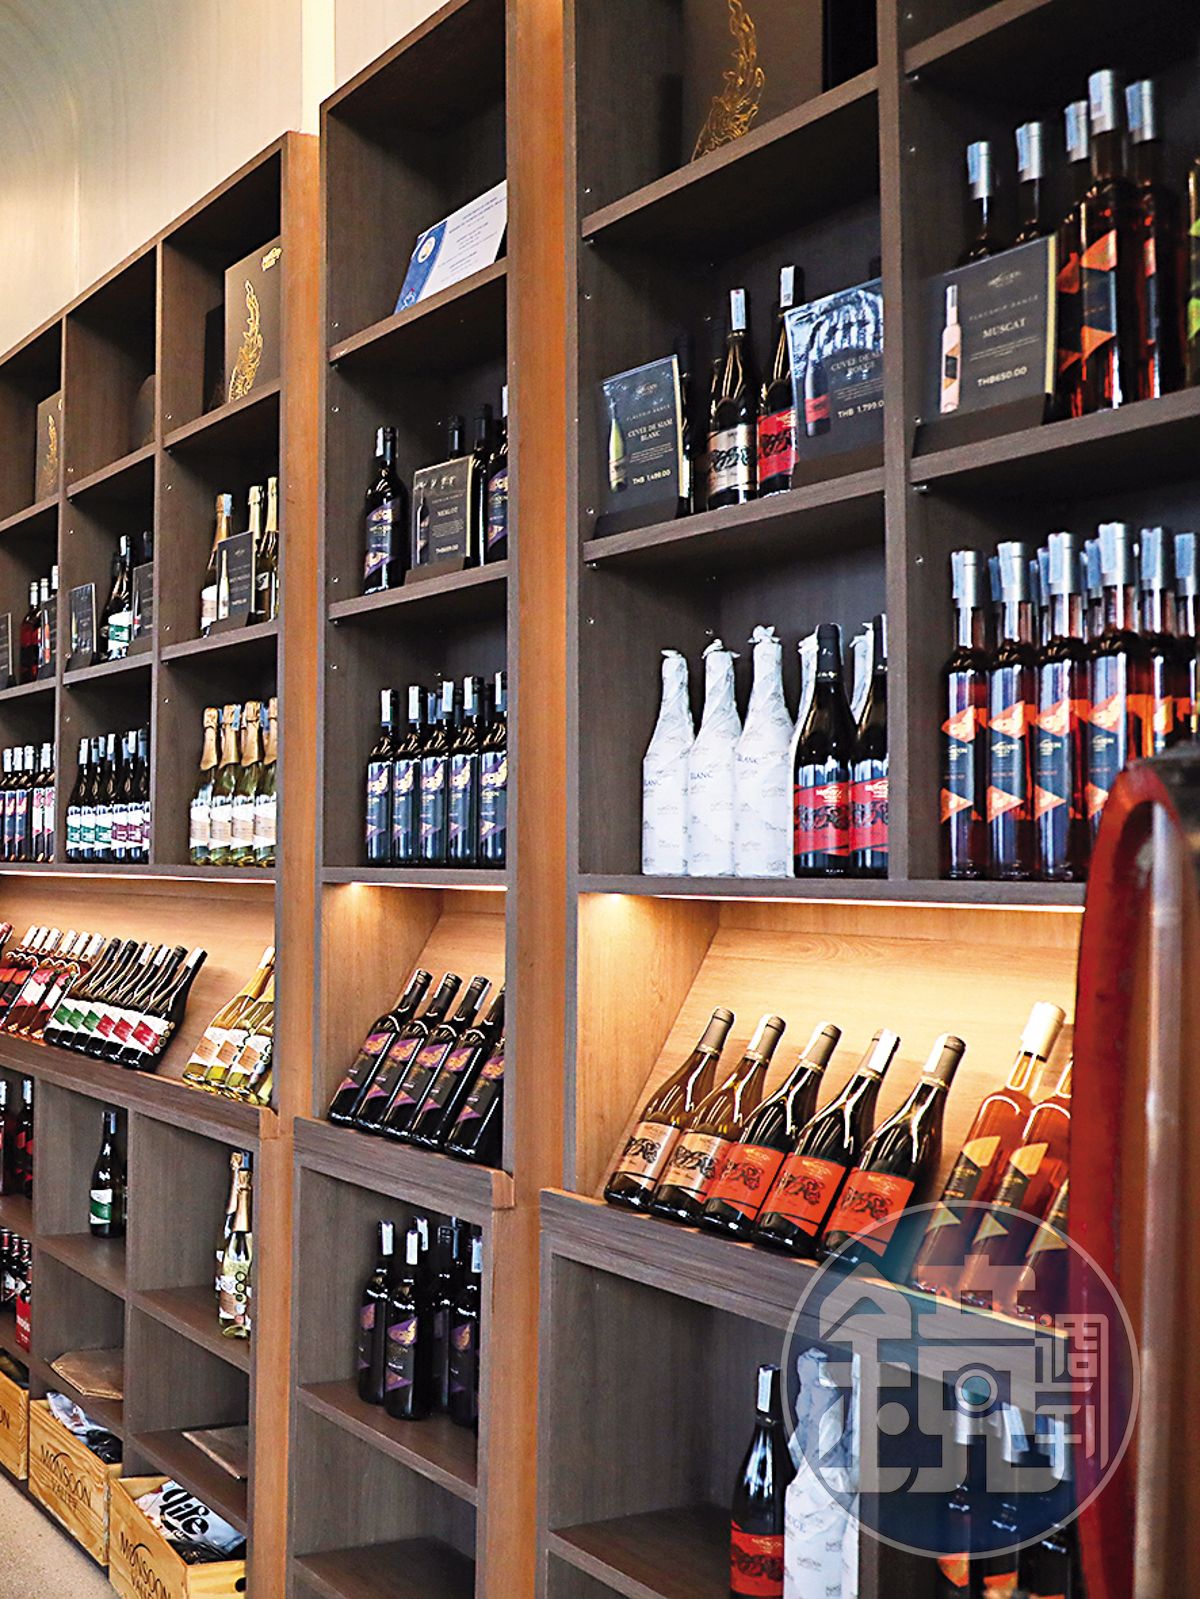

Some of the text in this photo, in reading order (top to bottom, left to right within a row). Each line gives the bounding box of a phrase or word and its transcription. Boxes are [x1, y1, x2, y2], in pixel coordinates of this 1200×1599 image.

[982, 317, 1027, 338] MUSCAT
[977, 365, 1028, 387] THB650.00
[837, 408, 854, 418] THB
[40, 1445, 92, 1508] MONSOON
[120, 1531, 172, 1599] MONSOON
